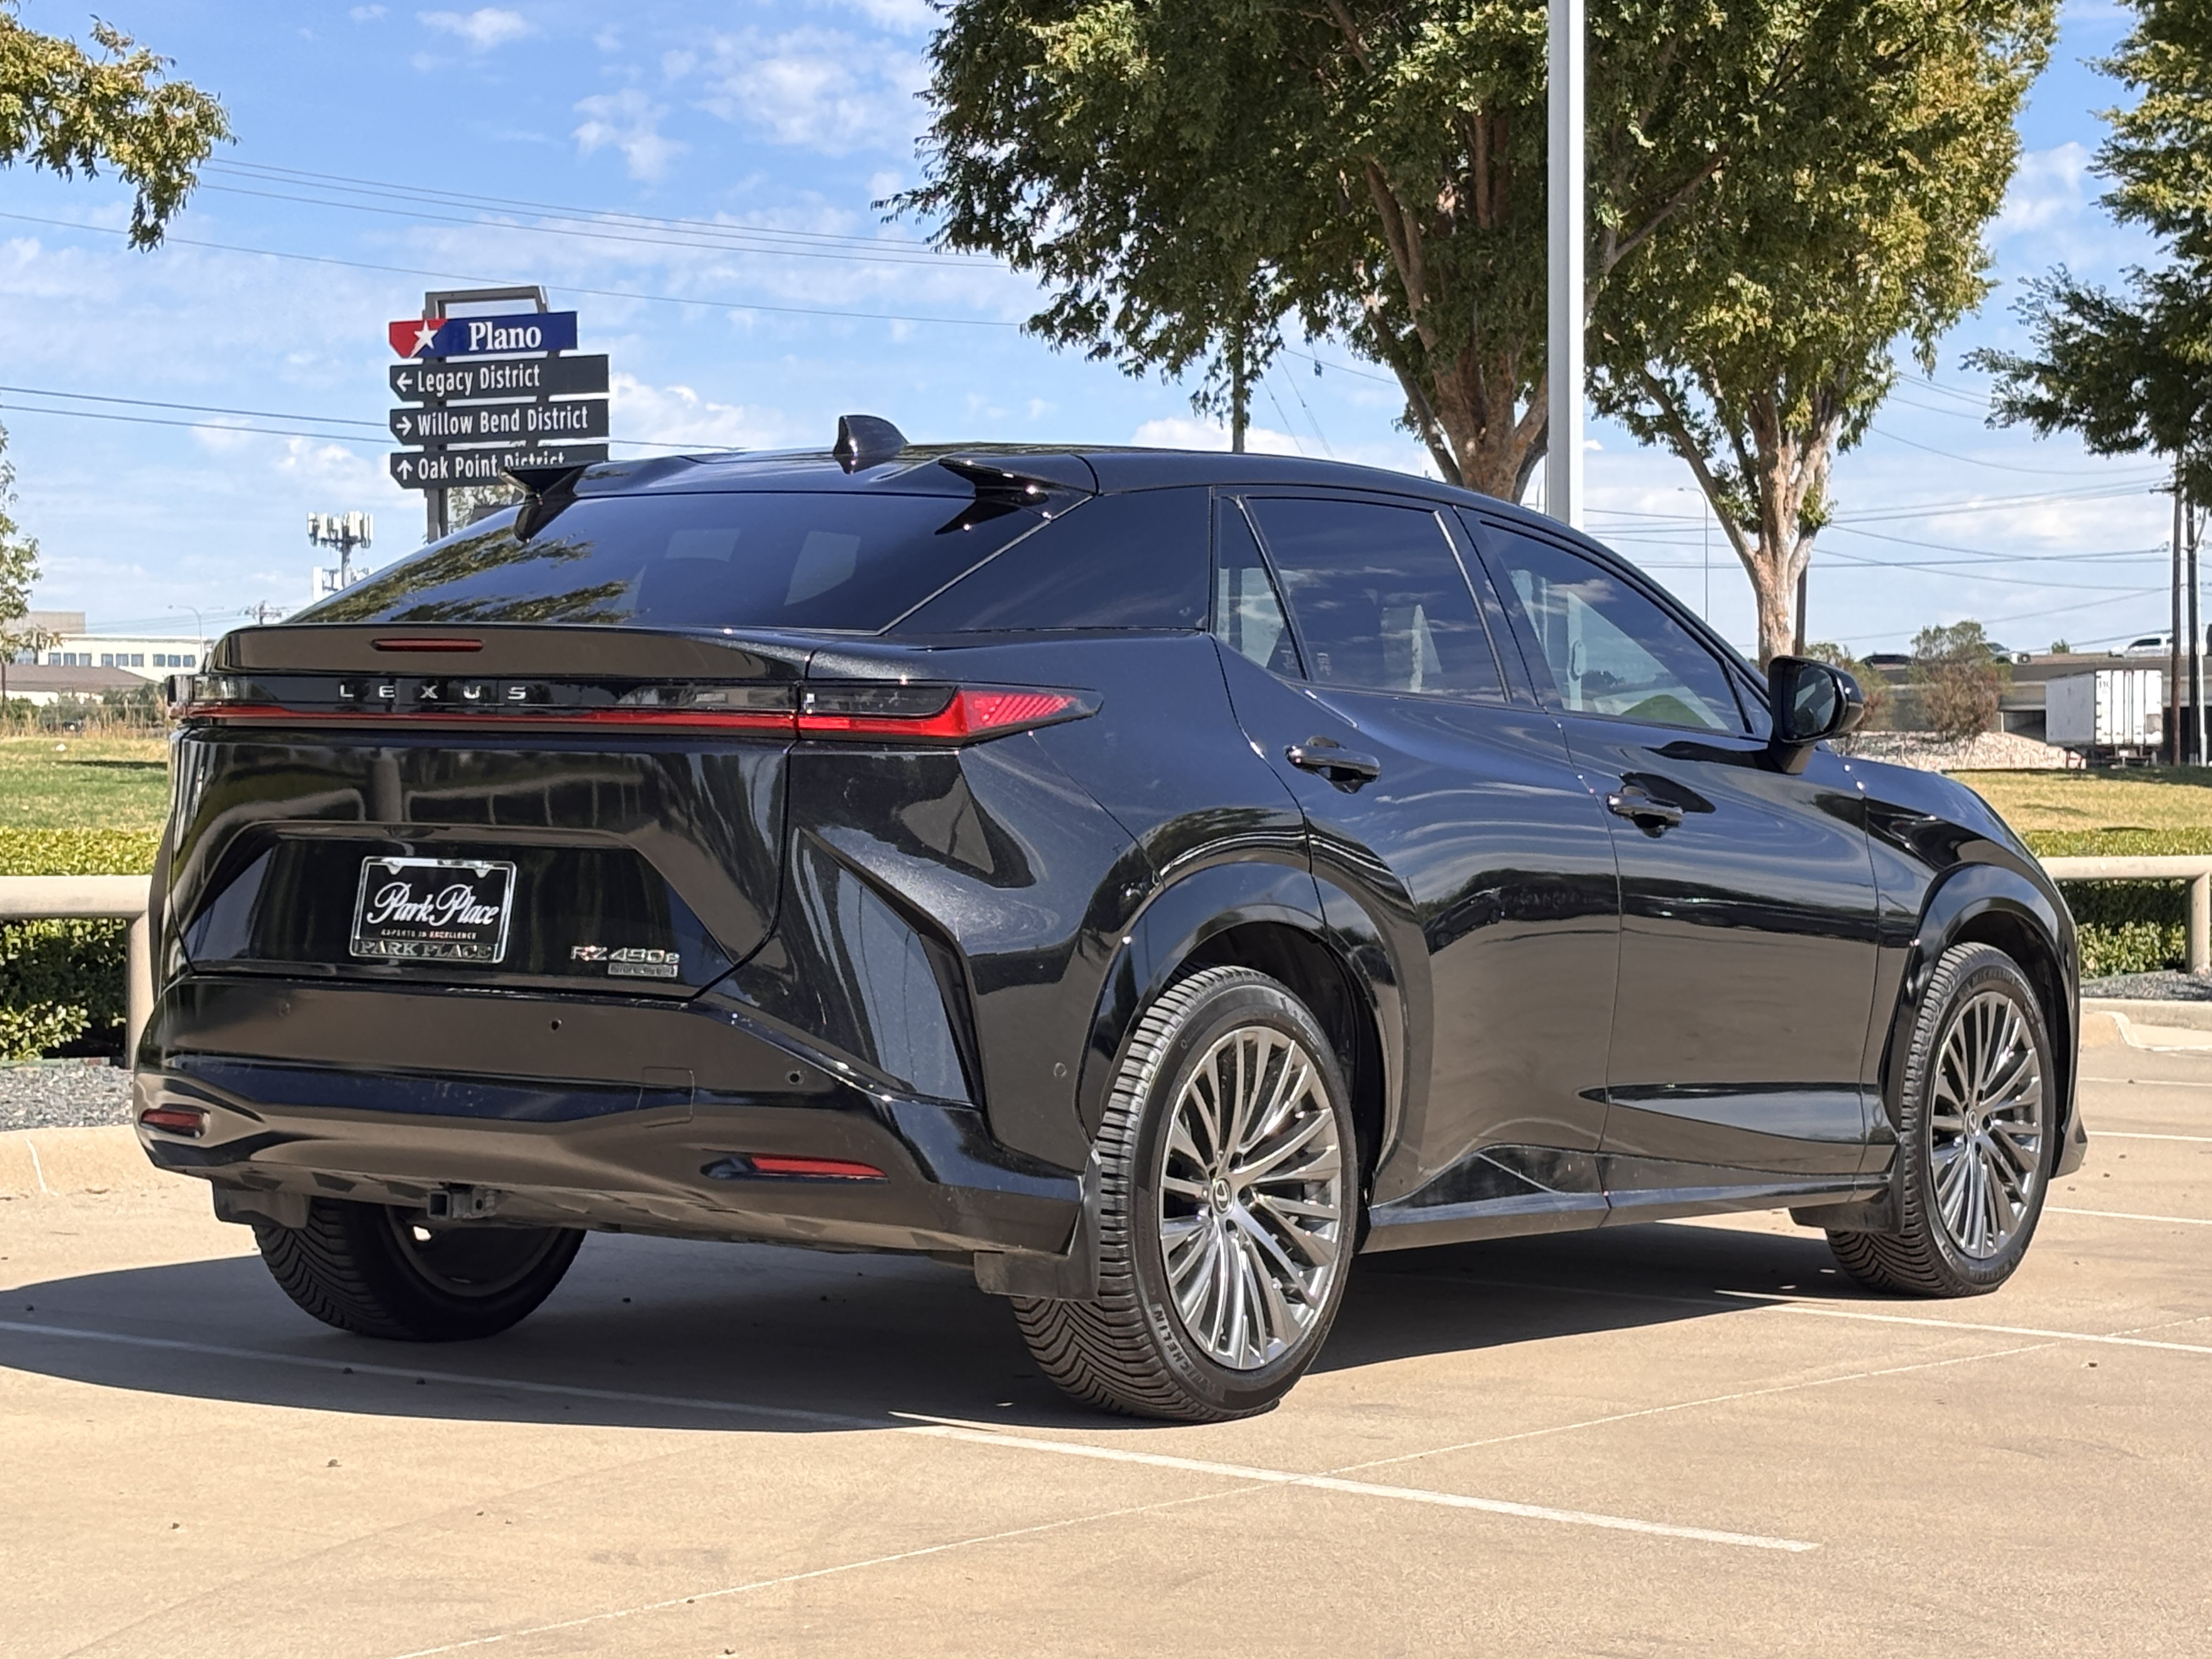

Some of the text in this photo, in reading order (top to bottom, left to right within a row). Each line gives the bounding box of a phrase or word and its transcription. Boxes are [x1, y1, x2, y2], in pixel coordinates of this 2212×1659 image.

[468, 321, 542, 352] Plano
[417, 363, 540, 397] Legacy District
[417, 405, 588, 437] Willow Bend District
[417, 455, 449, 479] Oak
[455, 453, 499, 478] Point
[340, 684, 527, 700] LEXUS
[366, 882, 499, 926] Park Place
[360, 940, 493, 958] PARK PLACE
[570, 945, 608, 961] RZ
